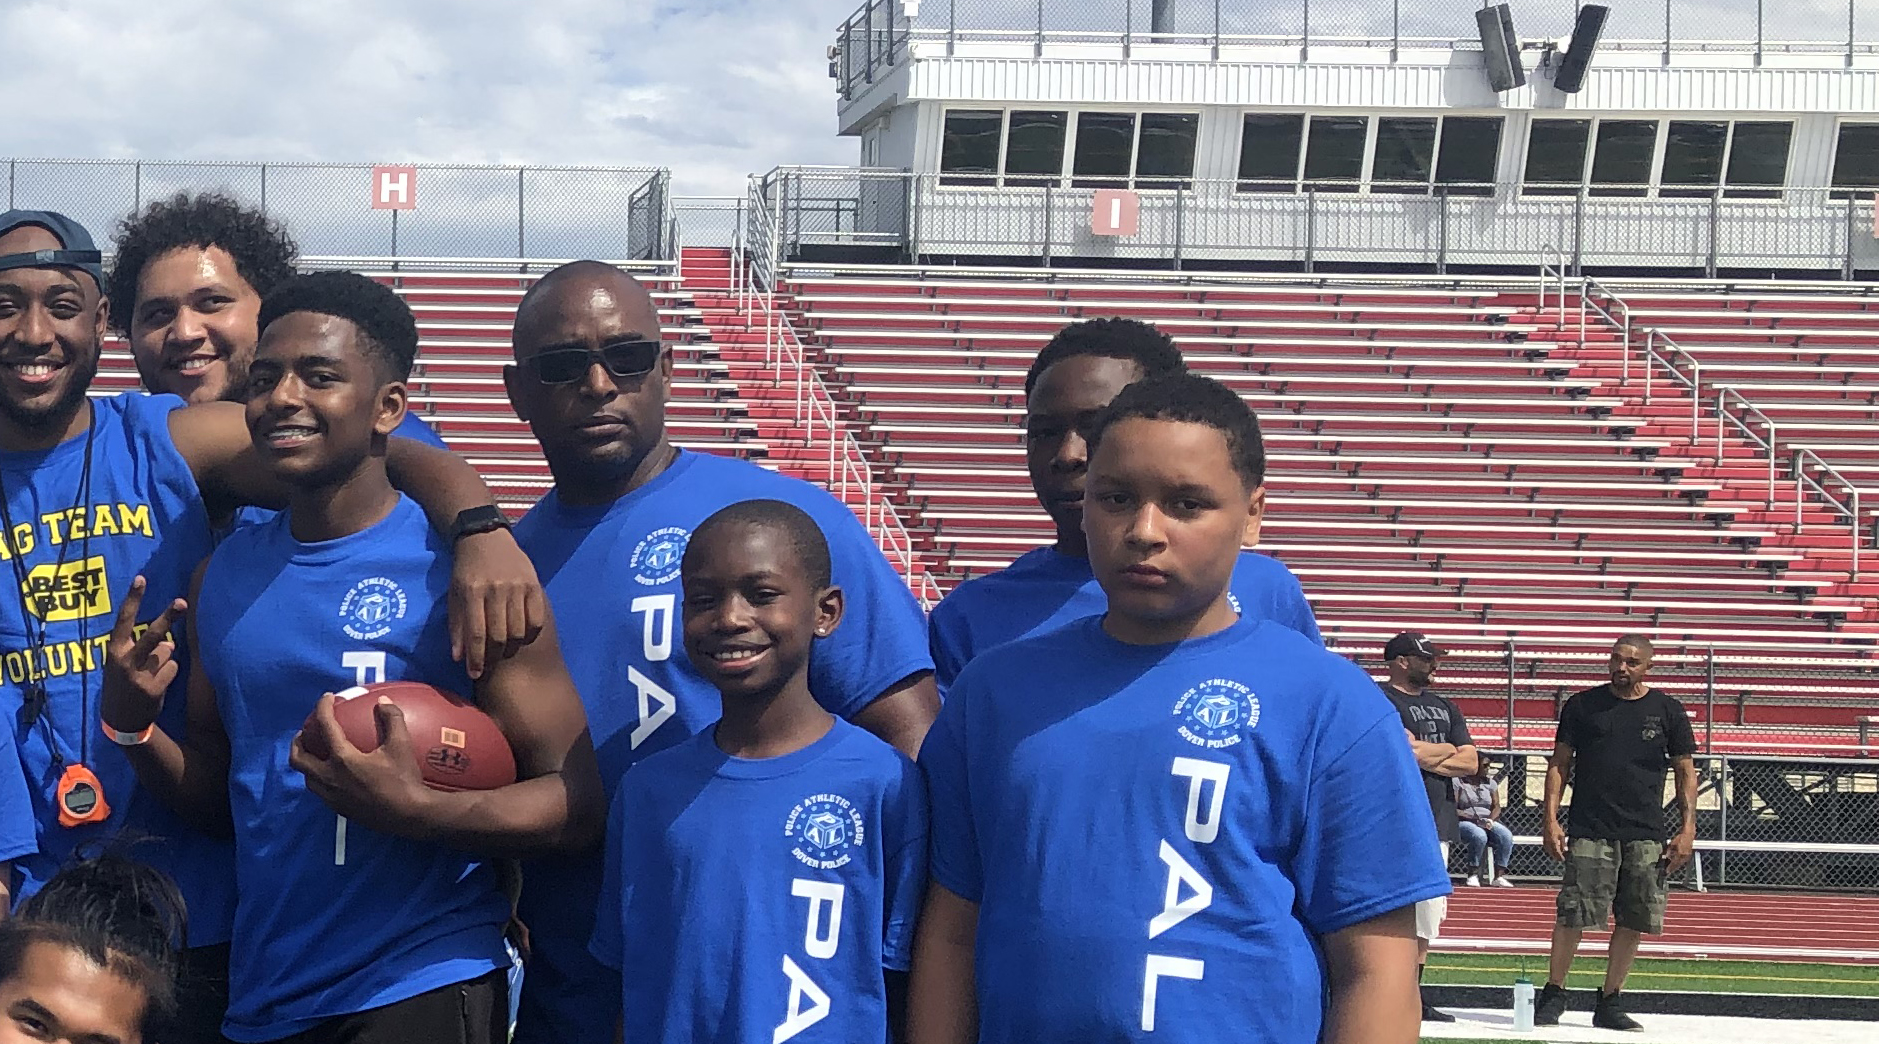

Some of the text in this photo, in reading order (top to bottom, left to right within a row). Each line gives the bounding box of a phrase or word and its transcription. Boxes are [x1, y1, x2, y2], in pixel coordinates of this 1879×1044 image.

[381, 172, 408, 203] H
[41, 503, 155, 545] TEAM
[31, 567, 103, 592] BEST
[36, 588, 100, 612] BUY
[1199, 678, 1250, 693] ATHLETIC
[1247, 693, 1260, 729] LEAGUE
[1178, 725, 1242, 749] DOVER POLICE
[784, 794, 864, 846] POLICE ATHLETIC LEAGUE
[791, 847, 852, 869] DOVER POLICE
[1141, 756, 1231, 1032] PAL
